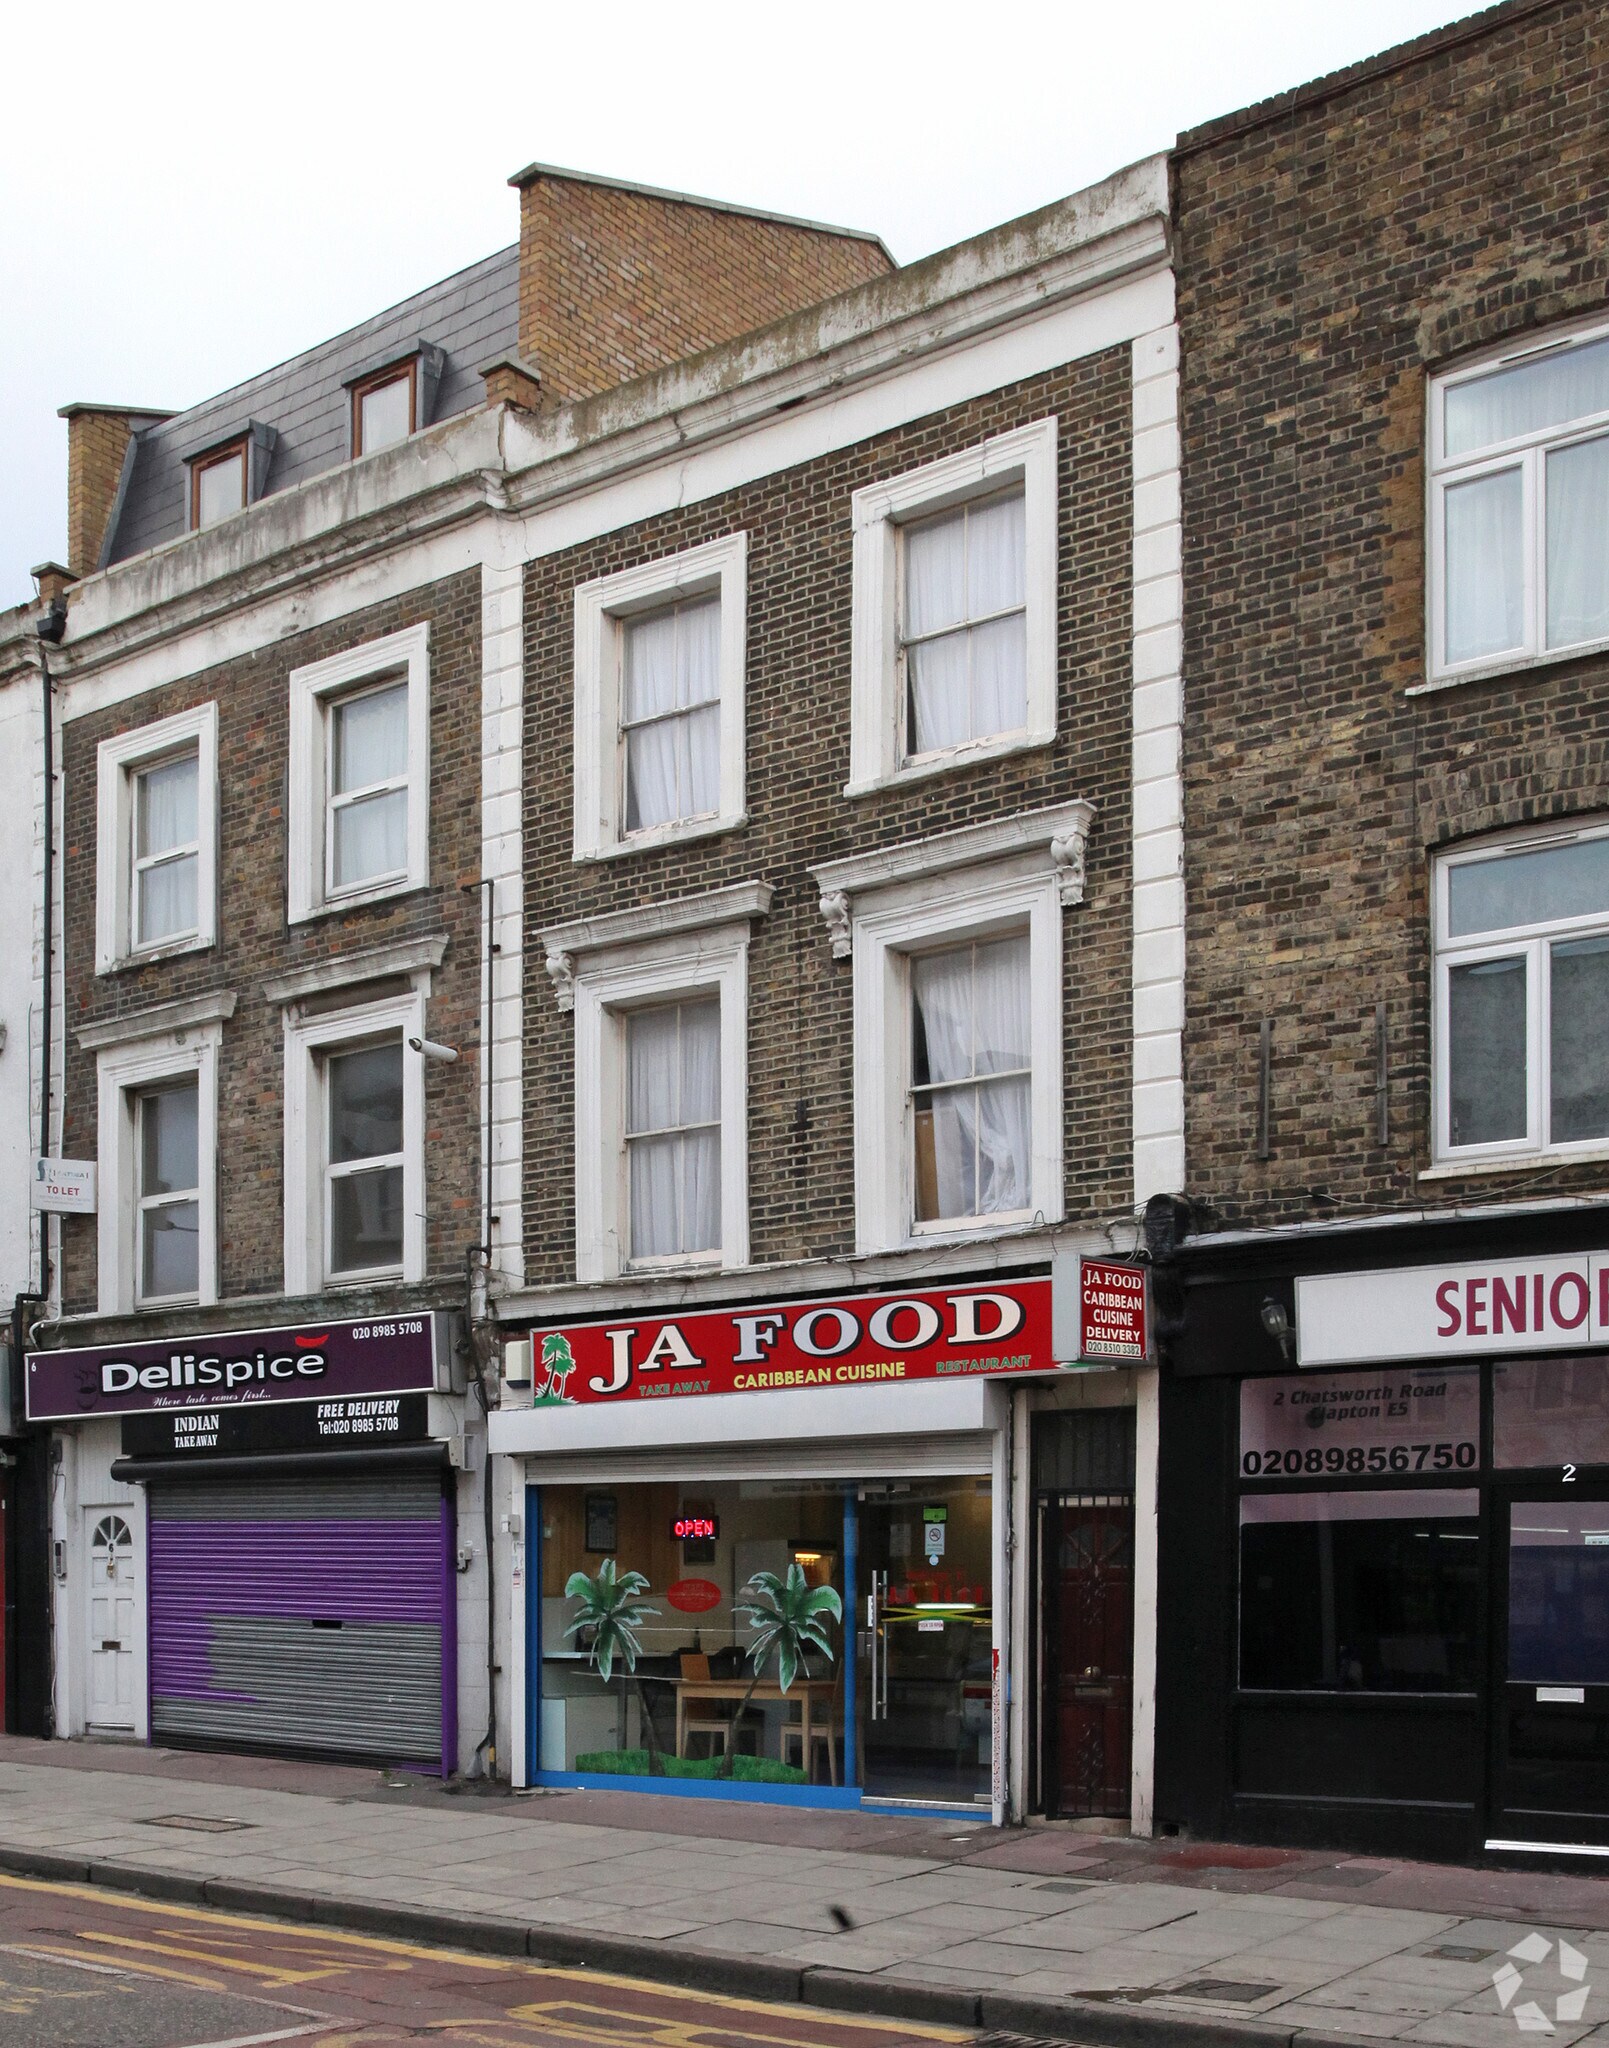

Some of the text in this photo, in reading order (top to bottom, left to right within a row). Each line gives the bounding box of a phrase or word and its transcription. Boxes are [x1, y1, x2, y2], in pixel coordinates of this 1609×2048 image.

[46, 1185, 80, 1196] TO LET
[1083, 1269, 1142, 1290] JA FOOD
[1083, 1289, 1142, 1311] CARIBBEAN
[1093, 1308, 1133, 1327] CUISINE
[352, 1321, 423, 1340] 020 8985 5708
[1086, 1326, 1140, 1342] DELIVERY
[588, 1293, 1023, 1393] JA FOOD
[1087, 1341, 1102, 1352] 020
[1103, 1342, 1121, 1354] 8510
[31, 1362, 37, 1372] 6
[101, 1353, 325, 1392] DeliSpice
[936, 1355, 1031, 1374] RESTAURANT
[733, 1361, 905, 1389] CARIBBEAN CUISINE
[639, 1379, 711, 1397] TAKE AWAY
[1273, 1382, 1447, 1406] 2 Chatsworth Road
[152, 1396, 181, 1407] Where
[185, 1393, 206, 1404] taste
[211, 1394, 238, 1402] comes
[317, 1399, 400, 1418] FREE DELIVERY
[1387, 1402, 1408, 1417] E5
[174, 1414, 219, 1433] INDIAN
[318, 1416, 399, 1435] Tel:020 8985 5708
[174, 1434, 218, 1448] TAKE AWAY
[1243, 1442, 1476, 1475] 02089856750
[1562, 1463, 1576, 1482] 2
[674, 1519, 714, 1537] OPEN
[108, 1542, 114, 1553] 6
